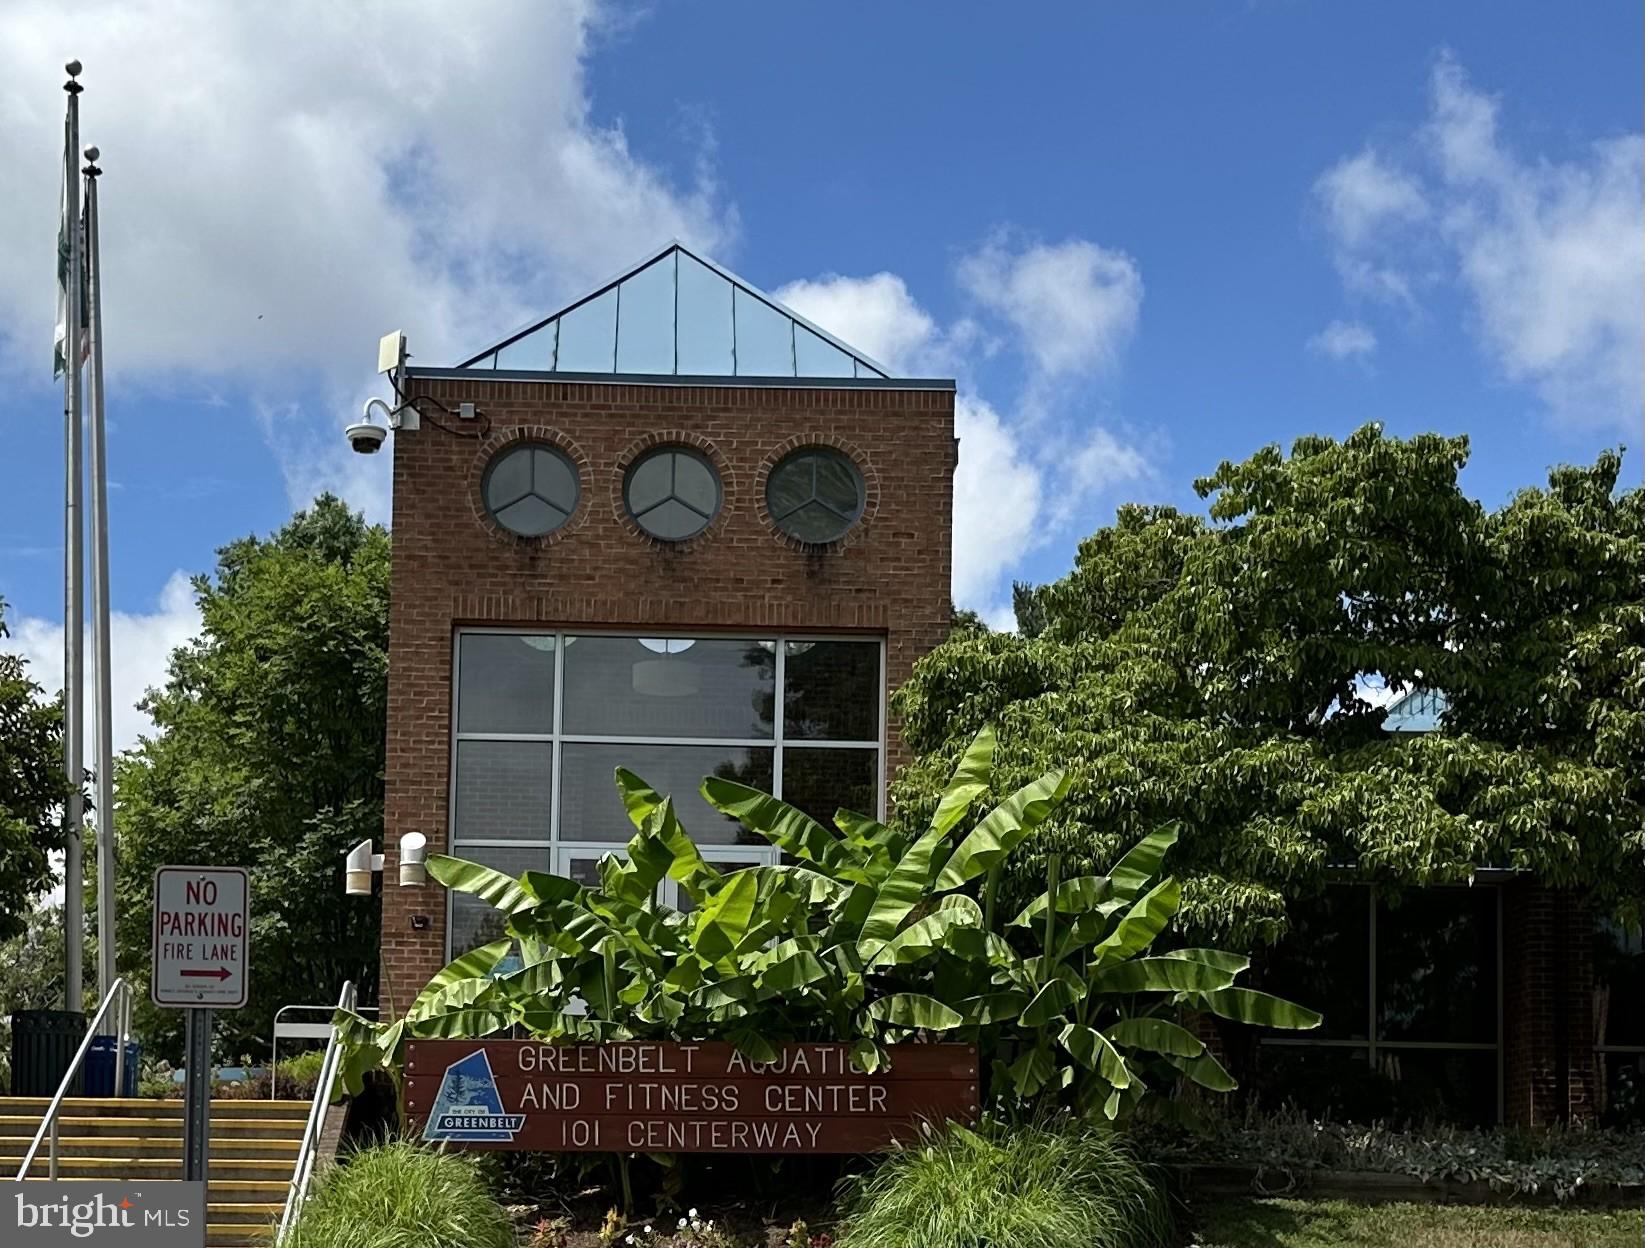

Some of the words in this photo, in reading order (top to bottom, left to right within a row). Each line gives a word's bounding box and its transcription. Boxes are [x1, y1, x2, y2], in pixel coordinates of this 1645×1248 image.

[186, 881, 217, 905] NO
[160, 912, 242, 937] PARKING
[164, 943, 193, 960] FIRE
[202, 944, 237, 961] LANE
[518, 1045, 699, 1073] GREENBELT
[519, 1083, 580, 1110] AND
[605, 1083, 739, 1112] FITNESS
[765, 1085, 887, 1112] CENTER
[444, 1117, 517, 1129] GREENBELT
[627, 1121, 822, 1148] CENTERWAY
